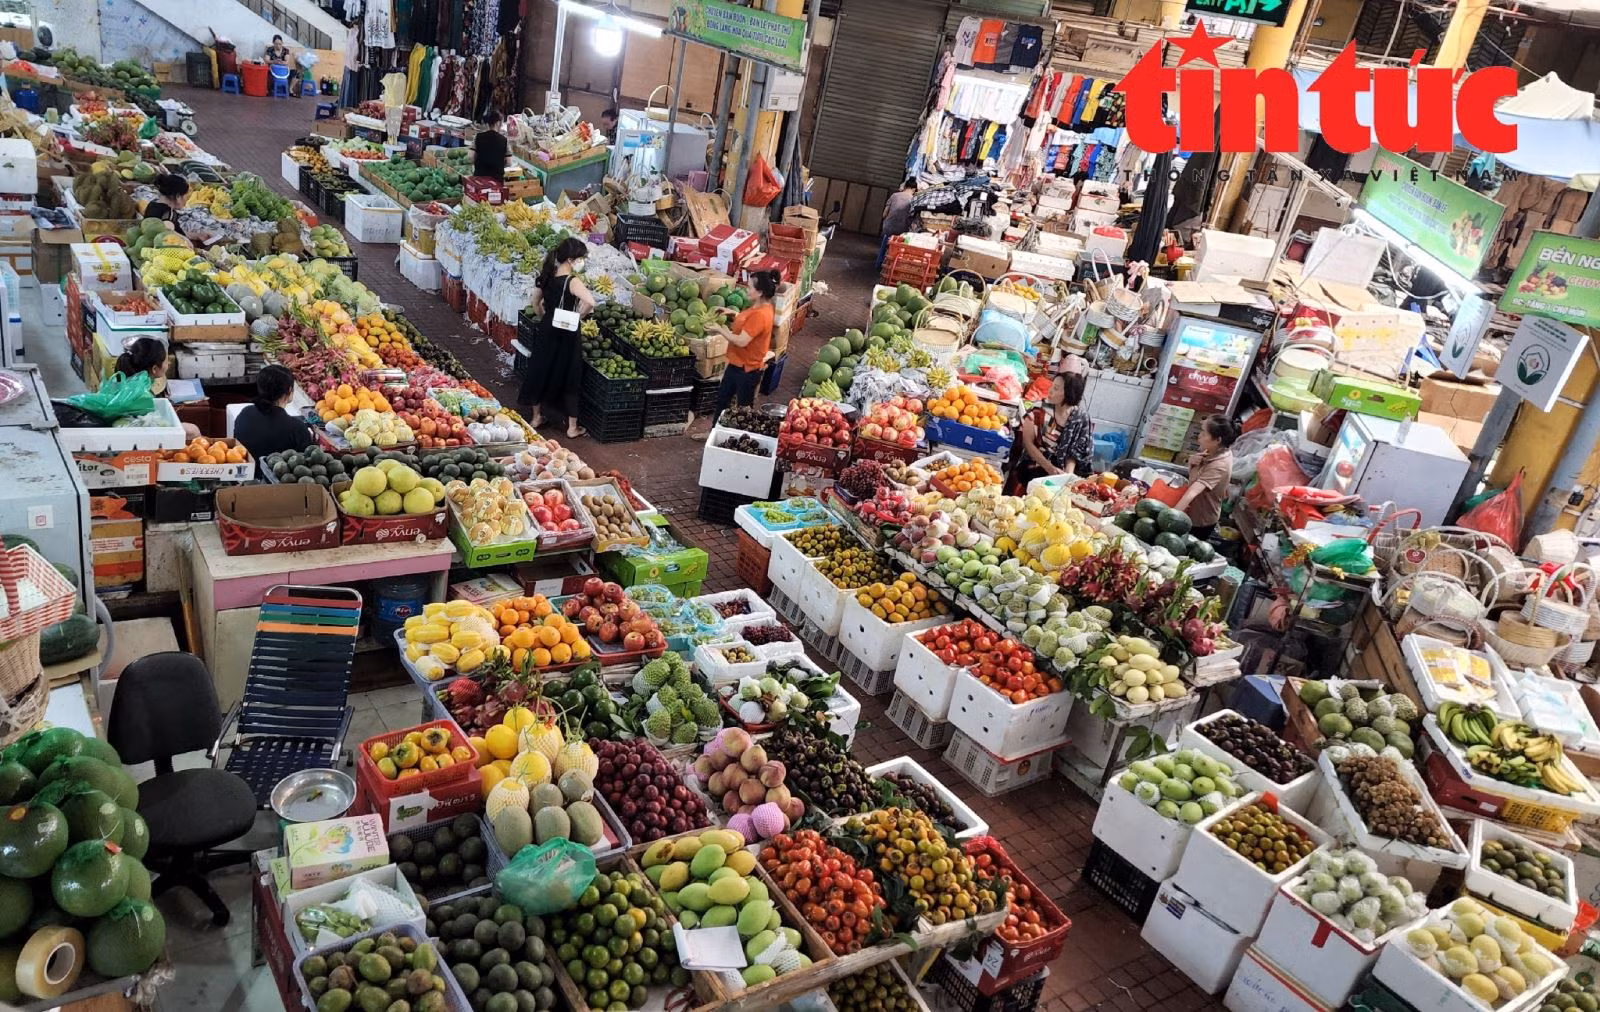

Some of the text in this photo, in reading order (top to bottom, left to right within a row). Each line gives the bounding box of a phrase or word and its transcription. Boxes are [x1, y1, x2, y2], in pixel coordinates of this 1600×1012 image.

[185, 467, 225, 476] CHERRIES
[389, 525, 421, 538] envy
[279, 536, 311, 548] envy
